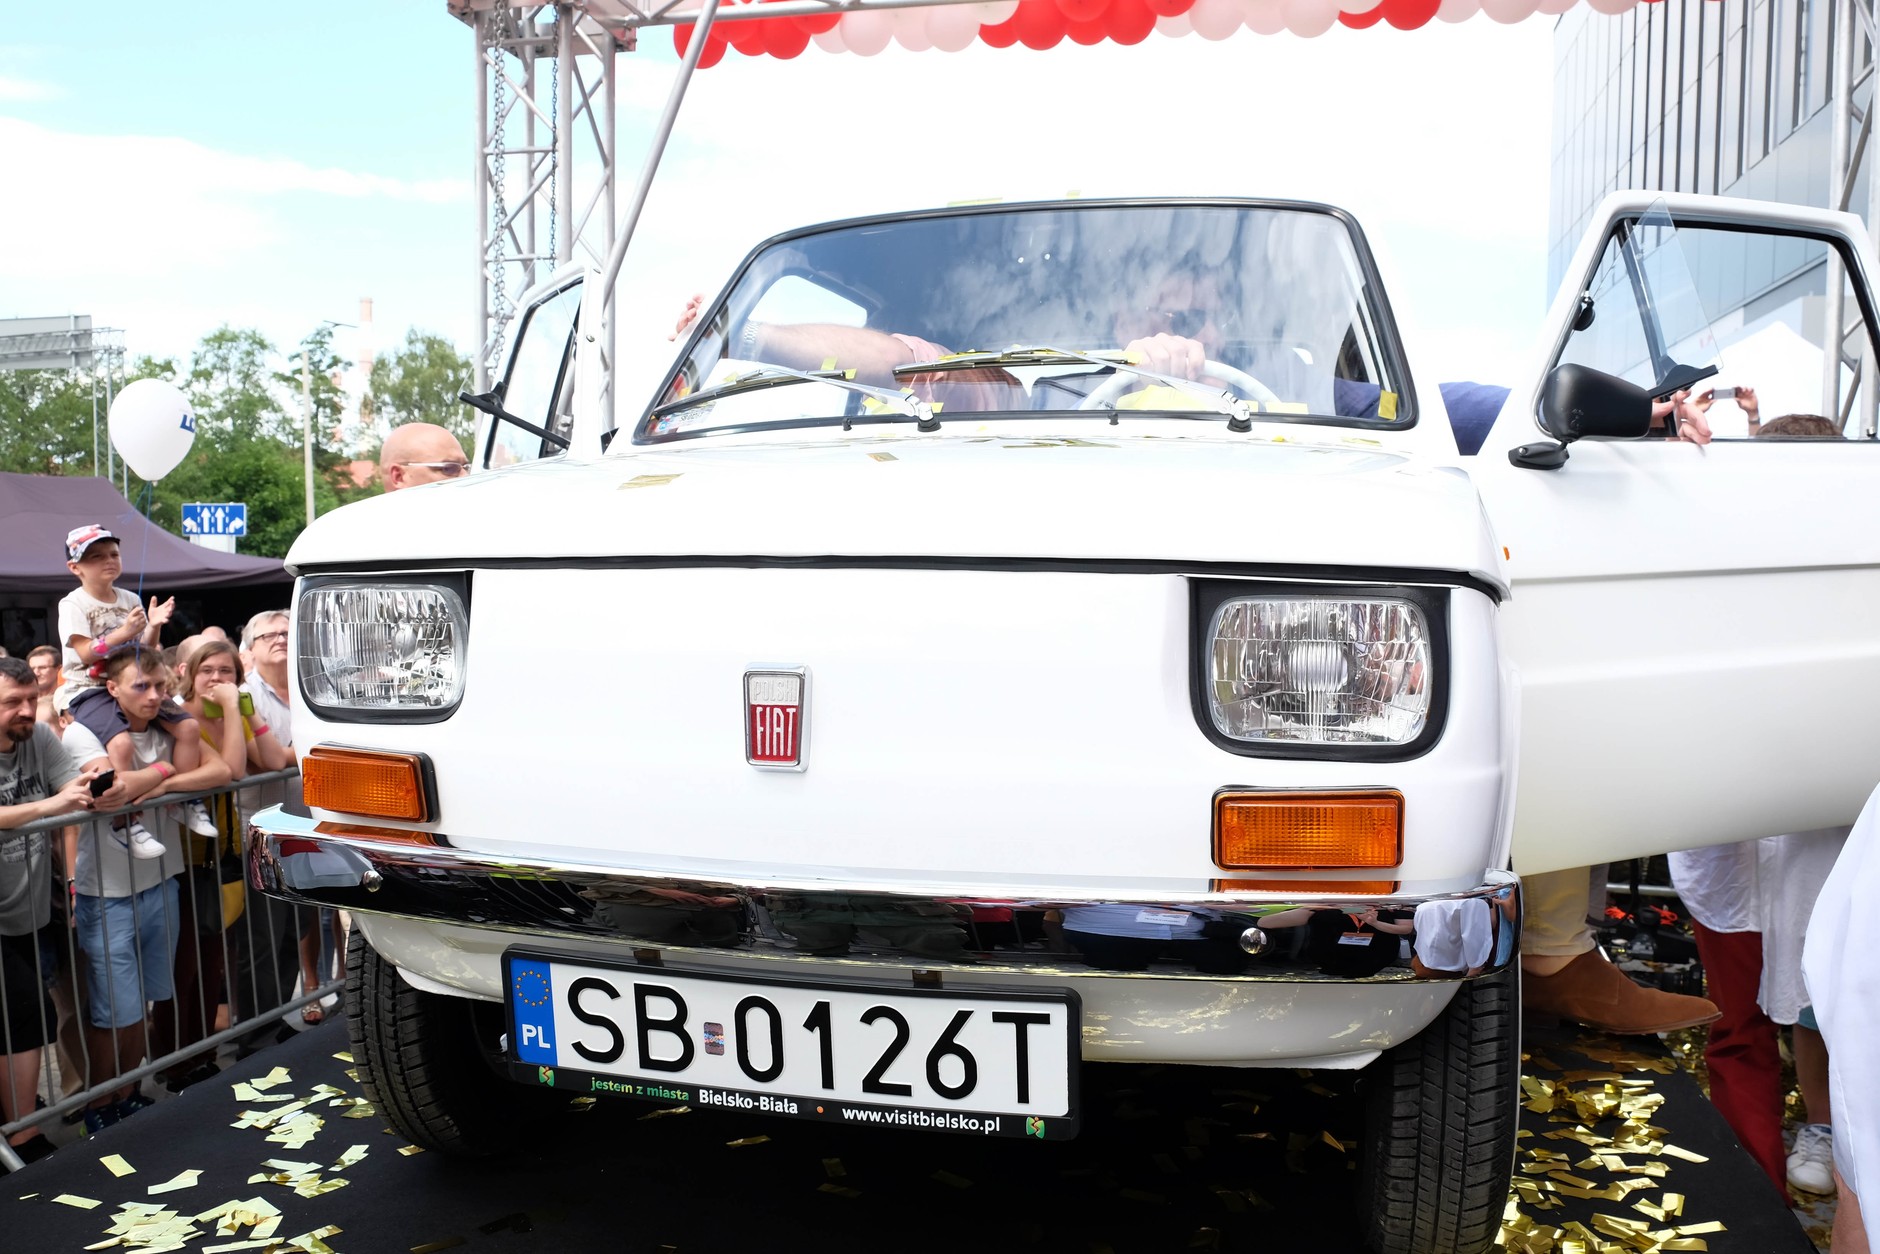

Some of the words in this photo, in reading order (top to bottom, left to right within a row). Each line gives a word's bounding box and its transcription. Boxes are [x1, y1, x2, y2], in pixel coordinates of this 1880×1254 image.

[756, 706, 797, 757] FIAT
[521, 1023, 551, 1049] PL
[566, 976, 695, 1073] SB
[733, 995, 1051, 1104] 0126T
[590, 1077, 633, 1094] jestem
[636, 1085, 643, 1095] z
[647, 1086, 690, 1101] miasta
[699, 1089, 798, 1115] Bielsko-Biała
[842, 1107, 1000, 1134] www.visitbielsko.pl
